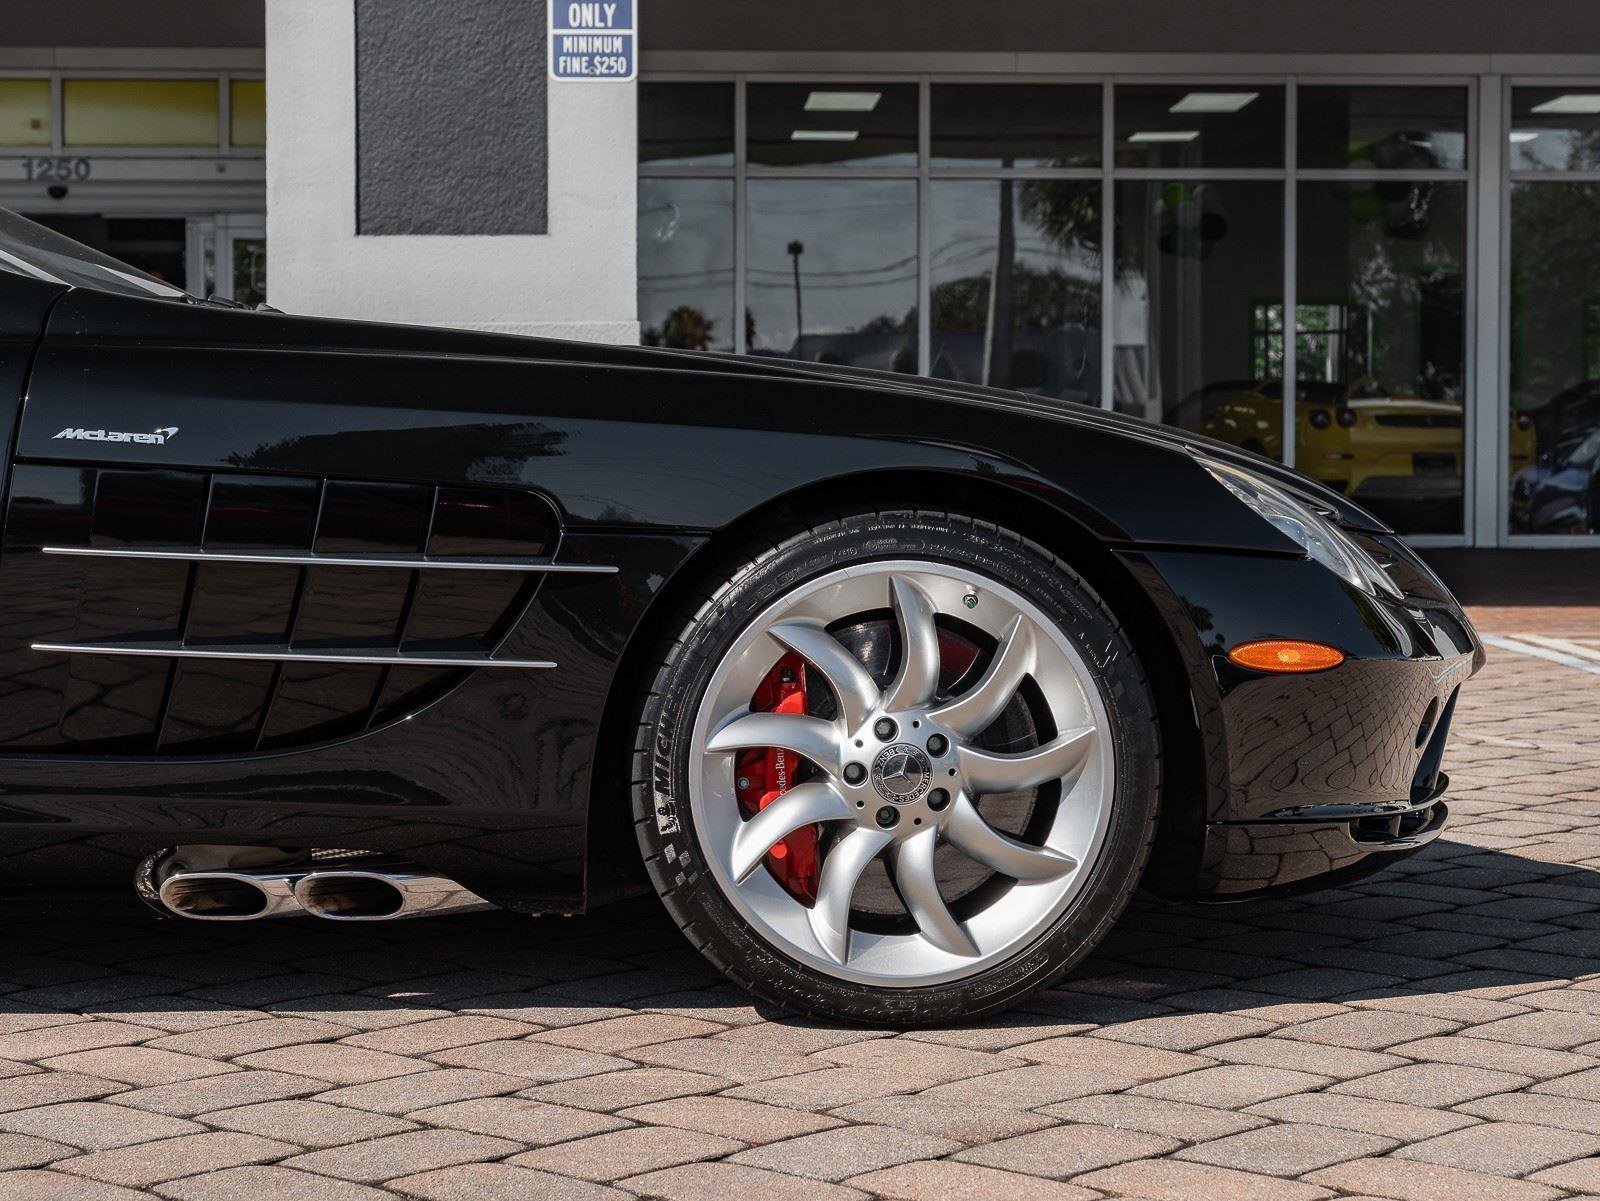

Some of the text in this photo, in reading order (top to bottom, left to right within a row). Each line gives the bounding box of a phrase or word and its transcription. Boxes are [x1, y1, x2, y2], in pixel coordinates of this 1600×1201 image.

[568, 3, 617, 28] ONLY
[563, 36, 623, 54] MINIMUM
[559, 55, 627, 76] FINE $250
[22, 157, 91, 181] 1250
[51, 427, 165, 445] McLaren
